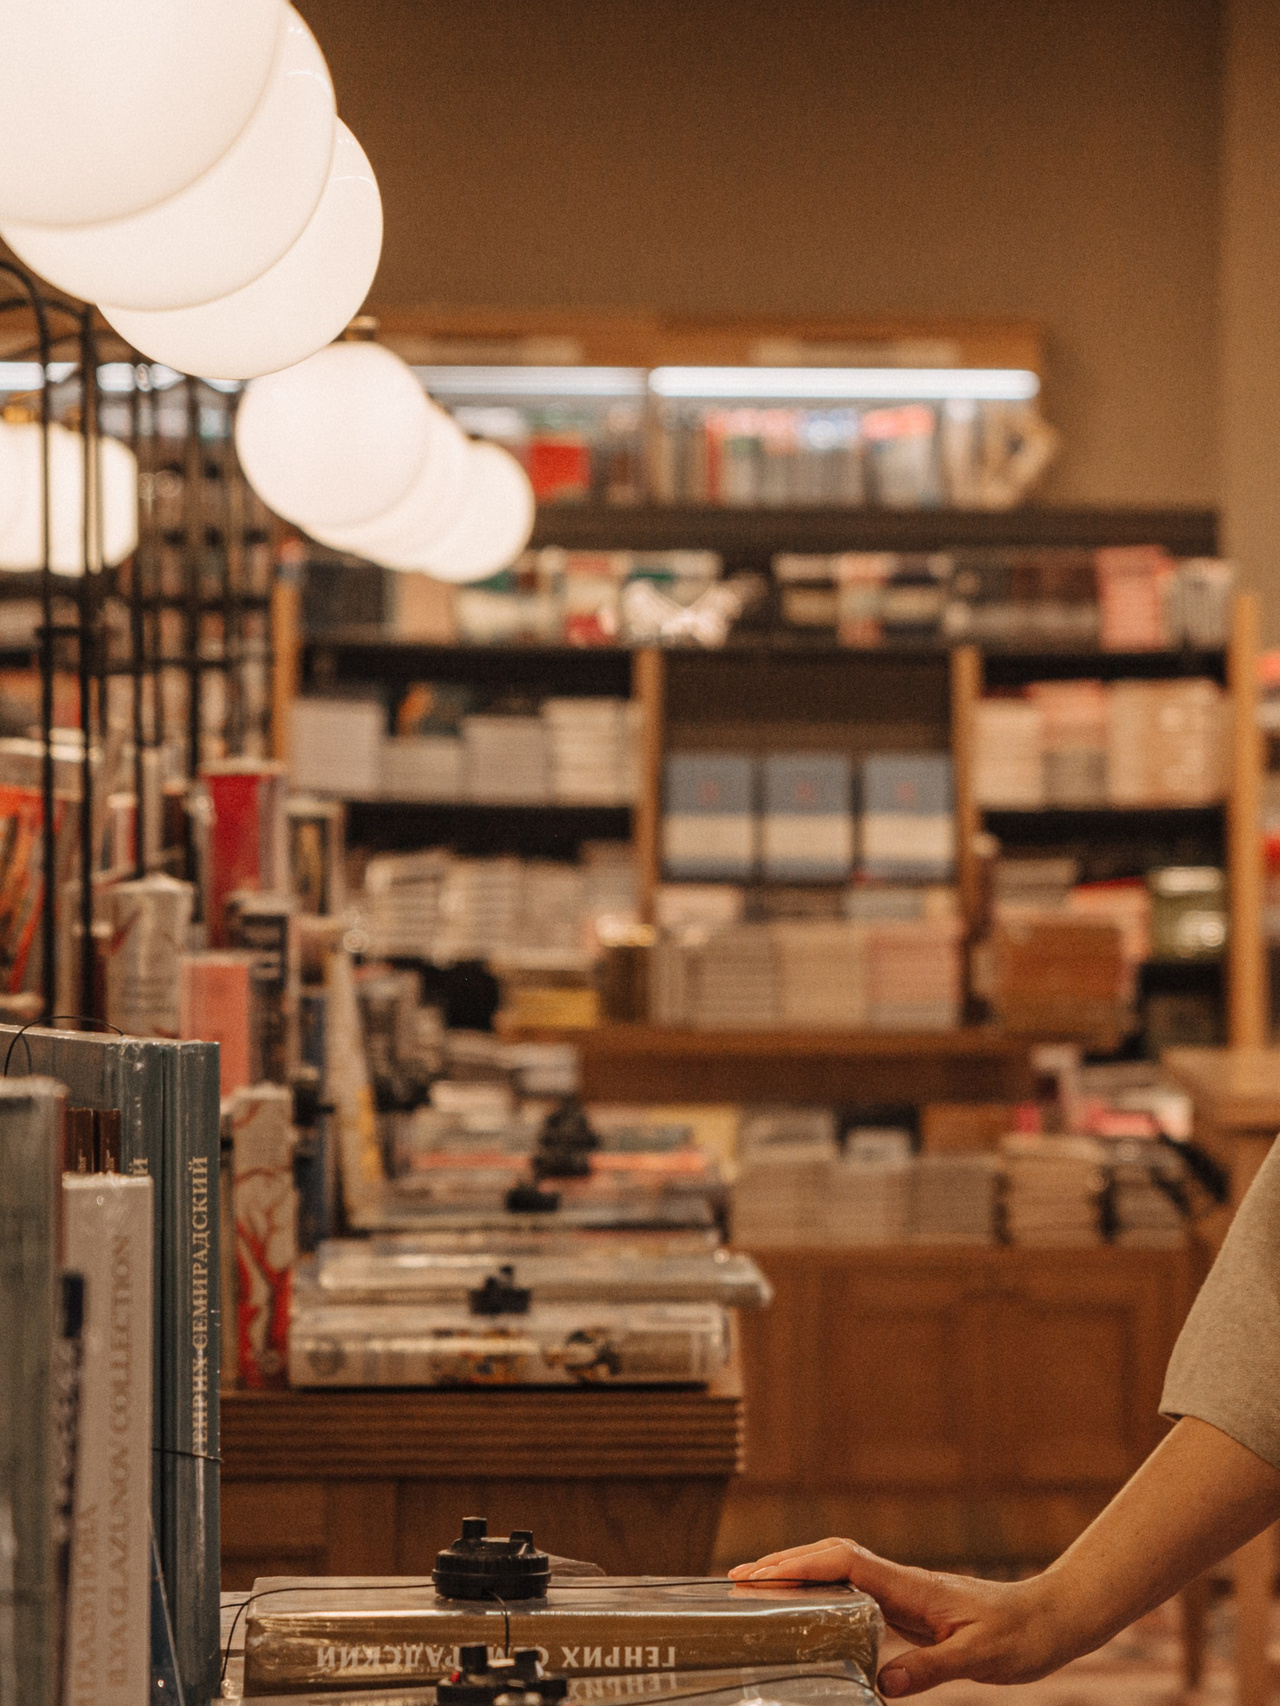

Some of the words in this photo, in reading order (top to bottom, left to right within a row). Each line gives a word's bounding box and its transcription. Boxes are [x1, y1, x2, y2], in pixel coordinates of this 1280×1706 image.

[187, 1156, 211, 1350] СЕМИРАДСКИЙ
[109, 1233, 132, 1435] COLLECTION
[191, 1356, 208, 1457] ГЕНРИХ
[107, 1440, 131, 1619] GLAZUNOV
[316, 1641, 550, 1674] СМРАДСКИЙ
[561, 1645, 676, 1669] ГЕНРИХ
